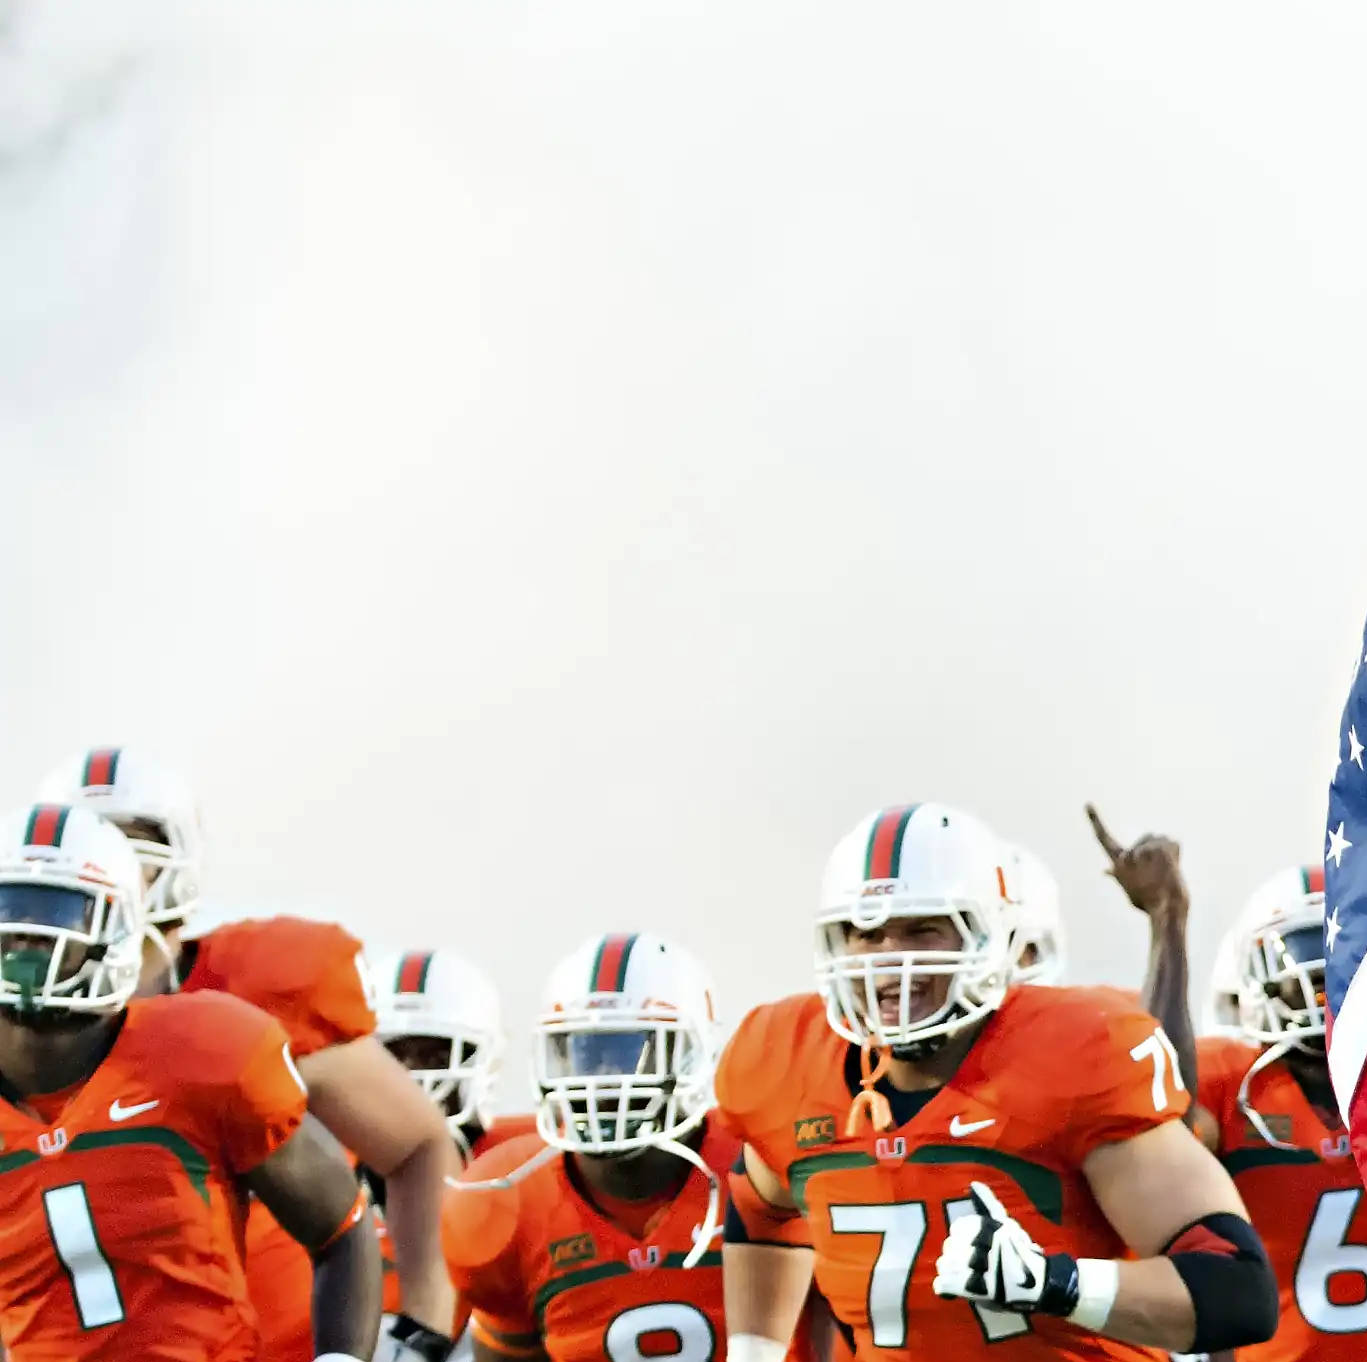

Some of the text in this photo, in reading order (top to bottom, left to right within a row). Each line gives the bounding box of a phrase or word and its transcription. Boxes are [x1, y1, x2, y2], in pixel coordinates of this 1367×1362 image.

[37, 1127, 68, 1156] U
[875, 1136, 906, 1160] U
[43, 1182, 126, 1331] 1
